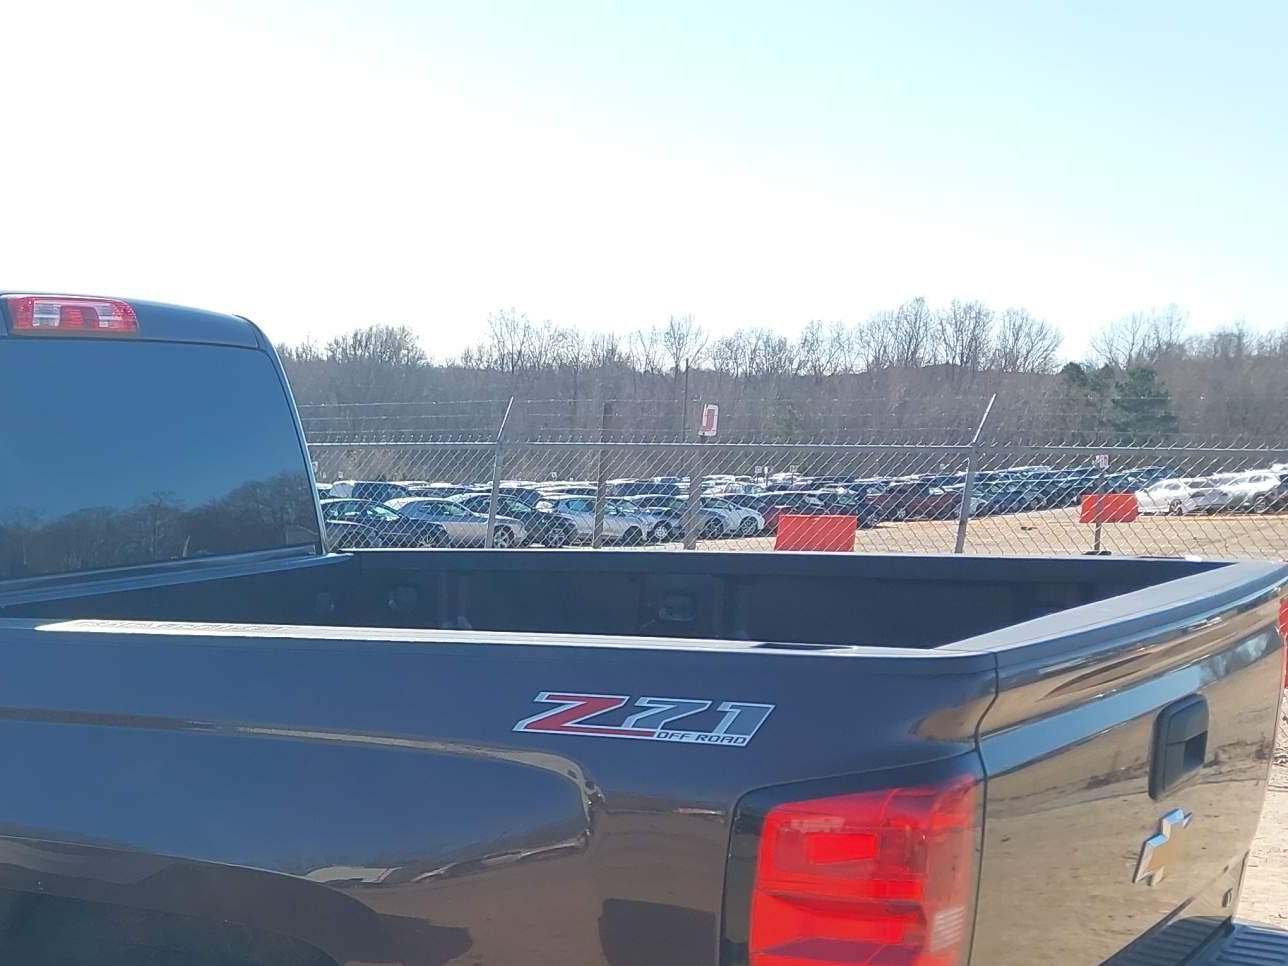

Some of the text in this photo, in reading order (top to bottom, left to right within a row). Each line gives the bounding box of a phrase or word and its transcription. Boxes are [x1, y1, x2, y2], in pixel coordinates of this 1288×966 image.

[513, 691, 776, 746] Z71
[656, 731, 746, 746] OFF ROAD
